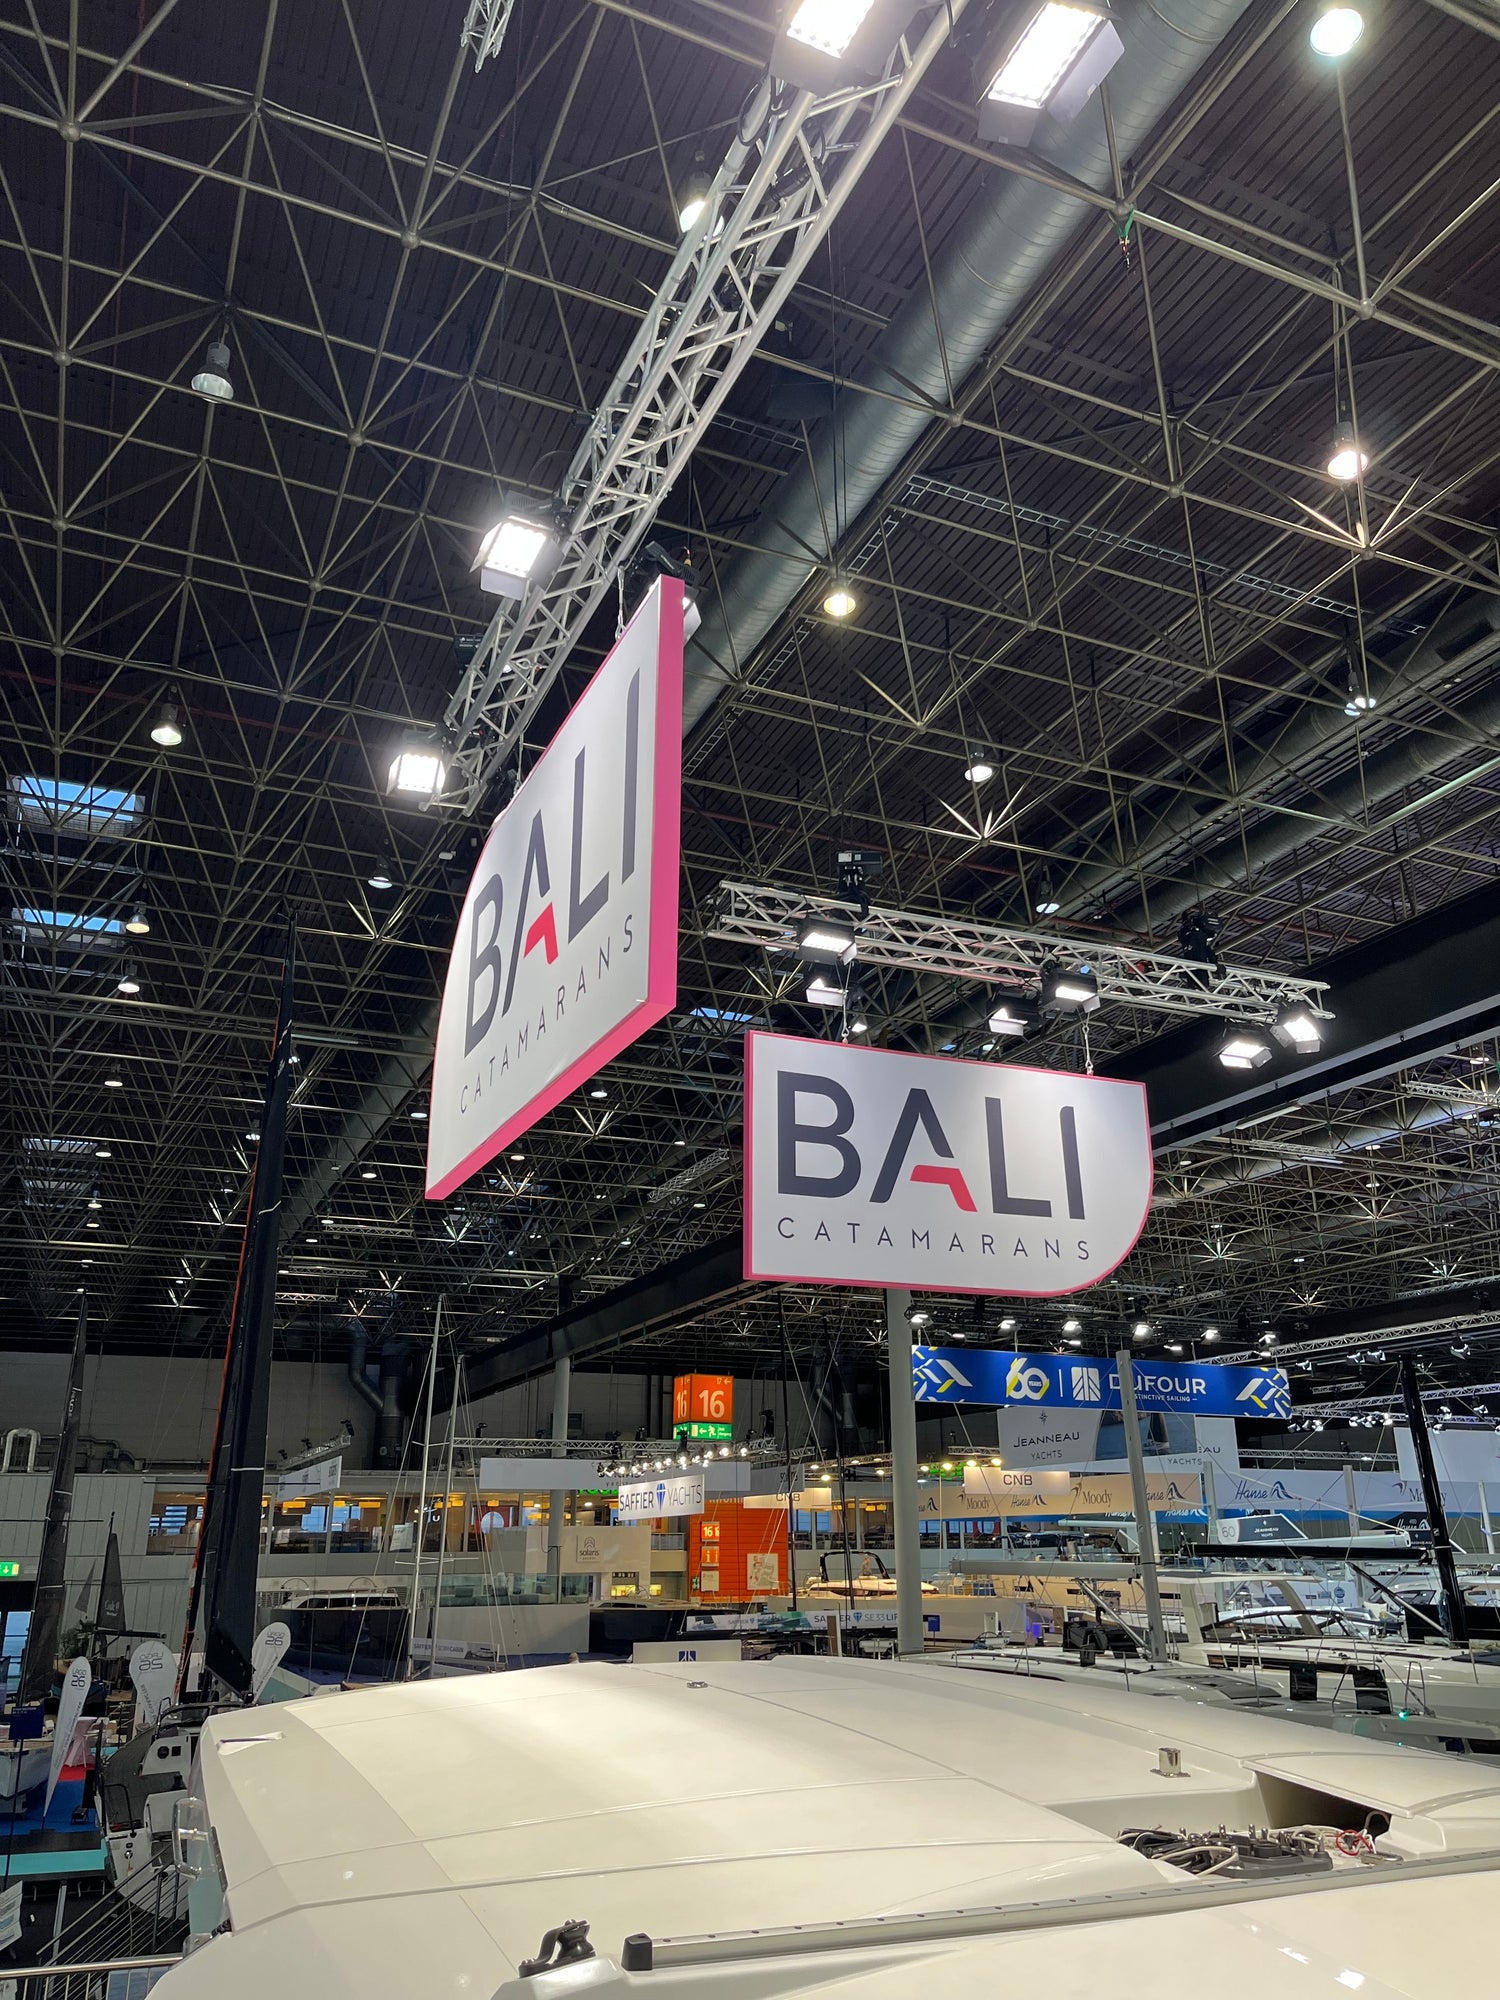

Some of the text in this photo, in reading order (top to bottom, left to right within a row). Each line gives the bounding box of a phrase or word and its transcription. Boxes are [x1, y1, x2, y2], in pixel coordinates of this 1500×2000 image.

[463, 667, 641, 1057] BALI
[460, 913, 635, 1115] CATAMARANS
[777, 1070, 1086, 1220] BALI
[777, 1216, 1090, 1261] CATAMARANS
[1006, 1357, 1050, 1401] 60
[676, 1390, 687, 1418] 16
[698, 1389, 725, 1418] 16
[1013, 1432, 1080, 1448] JEANNEAU
[1031, 1450, 1063, 1460] YACHTS
[1167, 1458, 1203, 1466] YACHTS
[1003, 1474, 1033, 1486] CNB
[620, 1484, 702, 1512] SAFFIER YACHTS
[1082, 1489, 1112, 1508] Moody
[1234, 1480, 1269, 1500] Hanse
[703, 1526, 713, 1537] 16
[1221, 1526, 1236, 1538] 60
[265, 1635, 284, 1646] 26
[71, 1674, 86, 1688] 26
